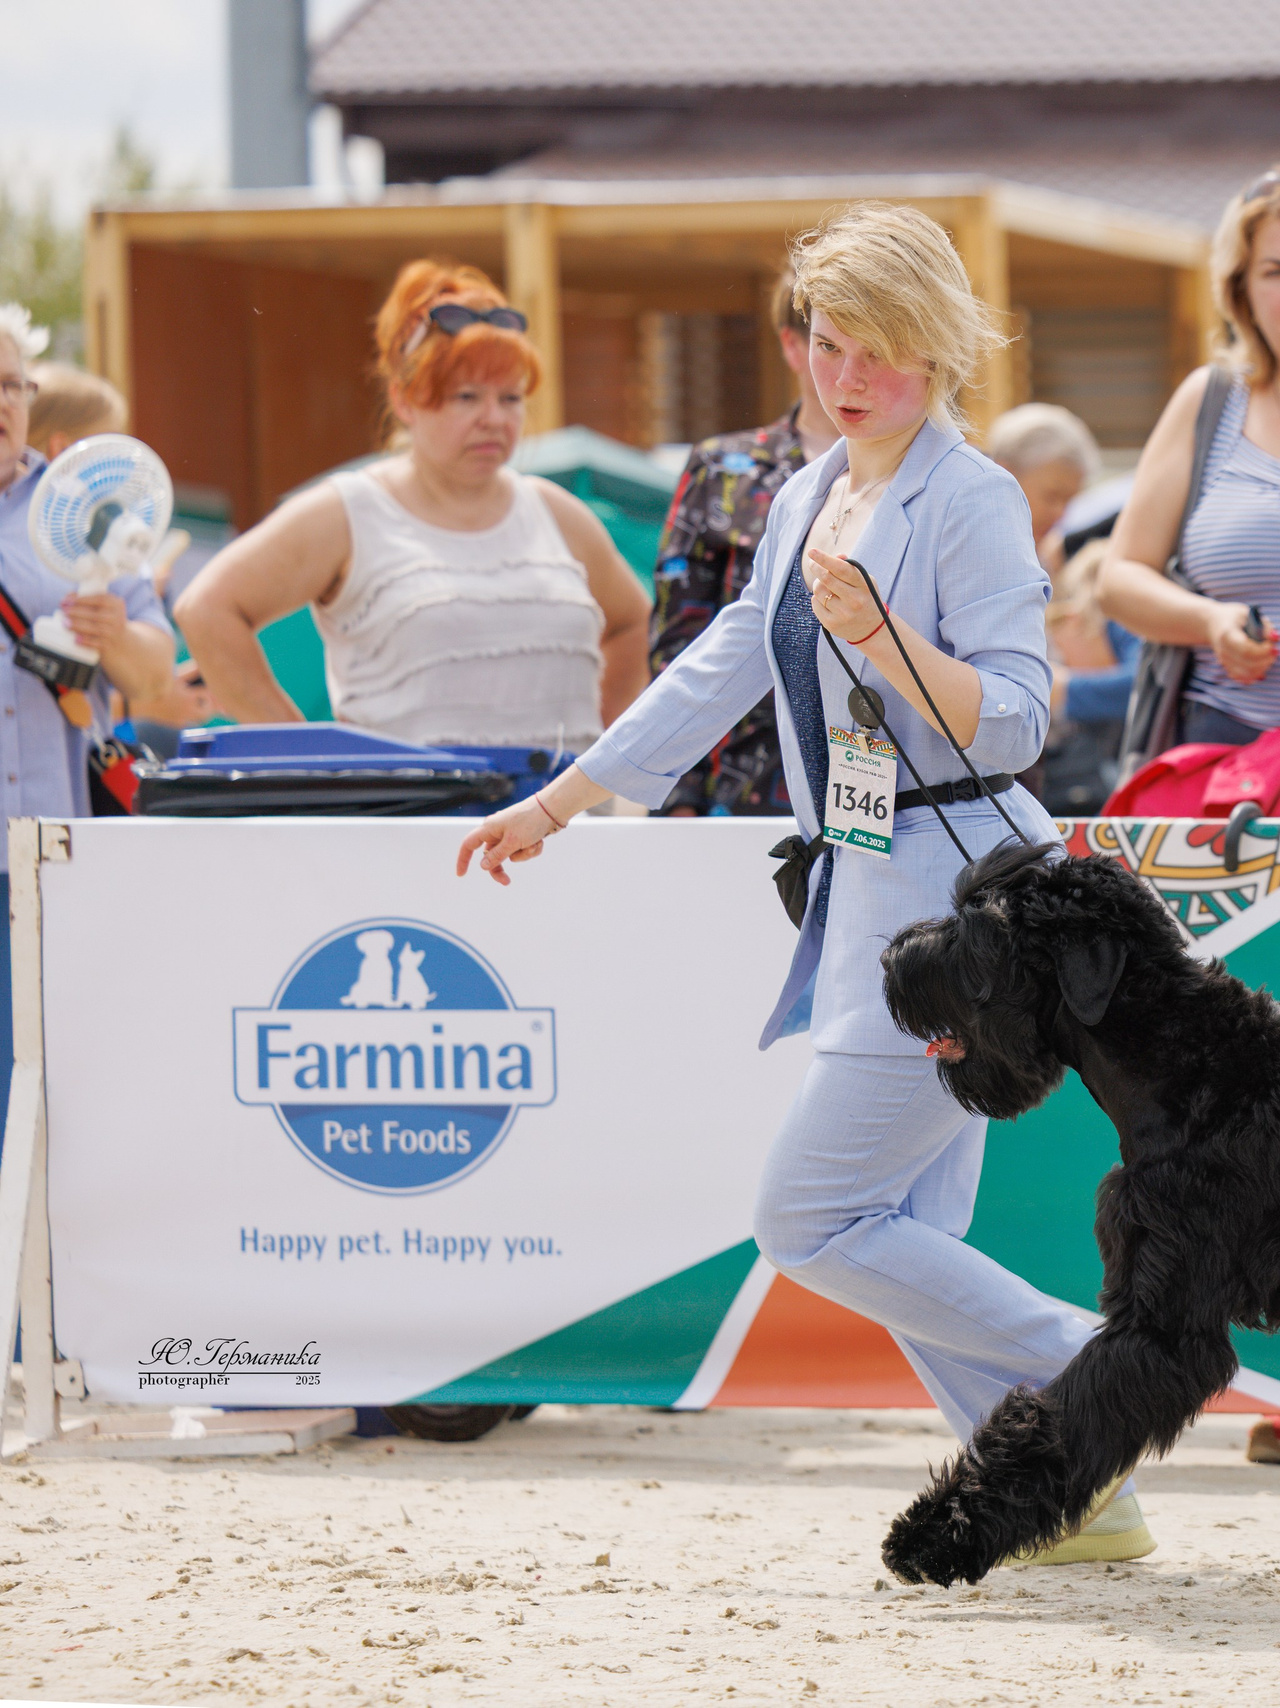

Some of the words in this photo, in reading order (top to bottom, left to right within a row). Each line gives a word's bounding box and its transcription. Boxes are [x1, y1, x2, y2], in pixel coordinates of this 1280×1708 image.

[855, 754, 881, 767] РОССИЯ
[833, 782, 888, 820] 1346
[853, 832, 886, 849] 7.06.2025
[256, 1023, 533, 1091] Farmina
[323, 1120, 373, 1154] Pet
[382, 1120, 472, 1155] Foods
[240, 1227, 327, 1261] Happy
[338, 1230, 391, 1261] pet.
[402, 1228, 491, 1262] Happy
[503, 1232, 563, 1263] you.
